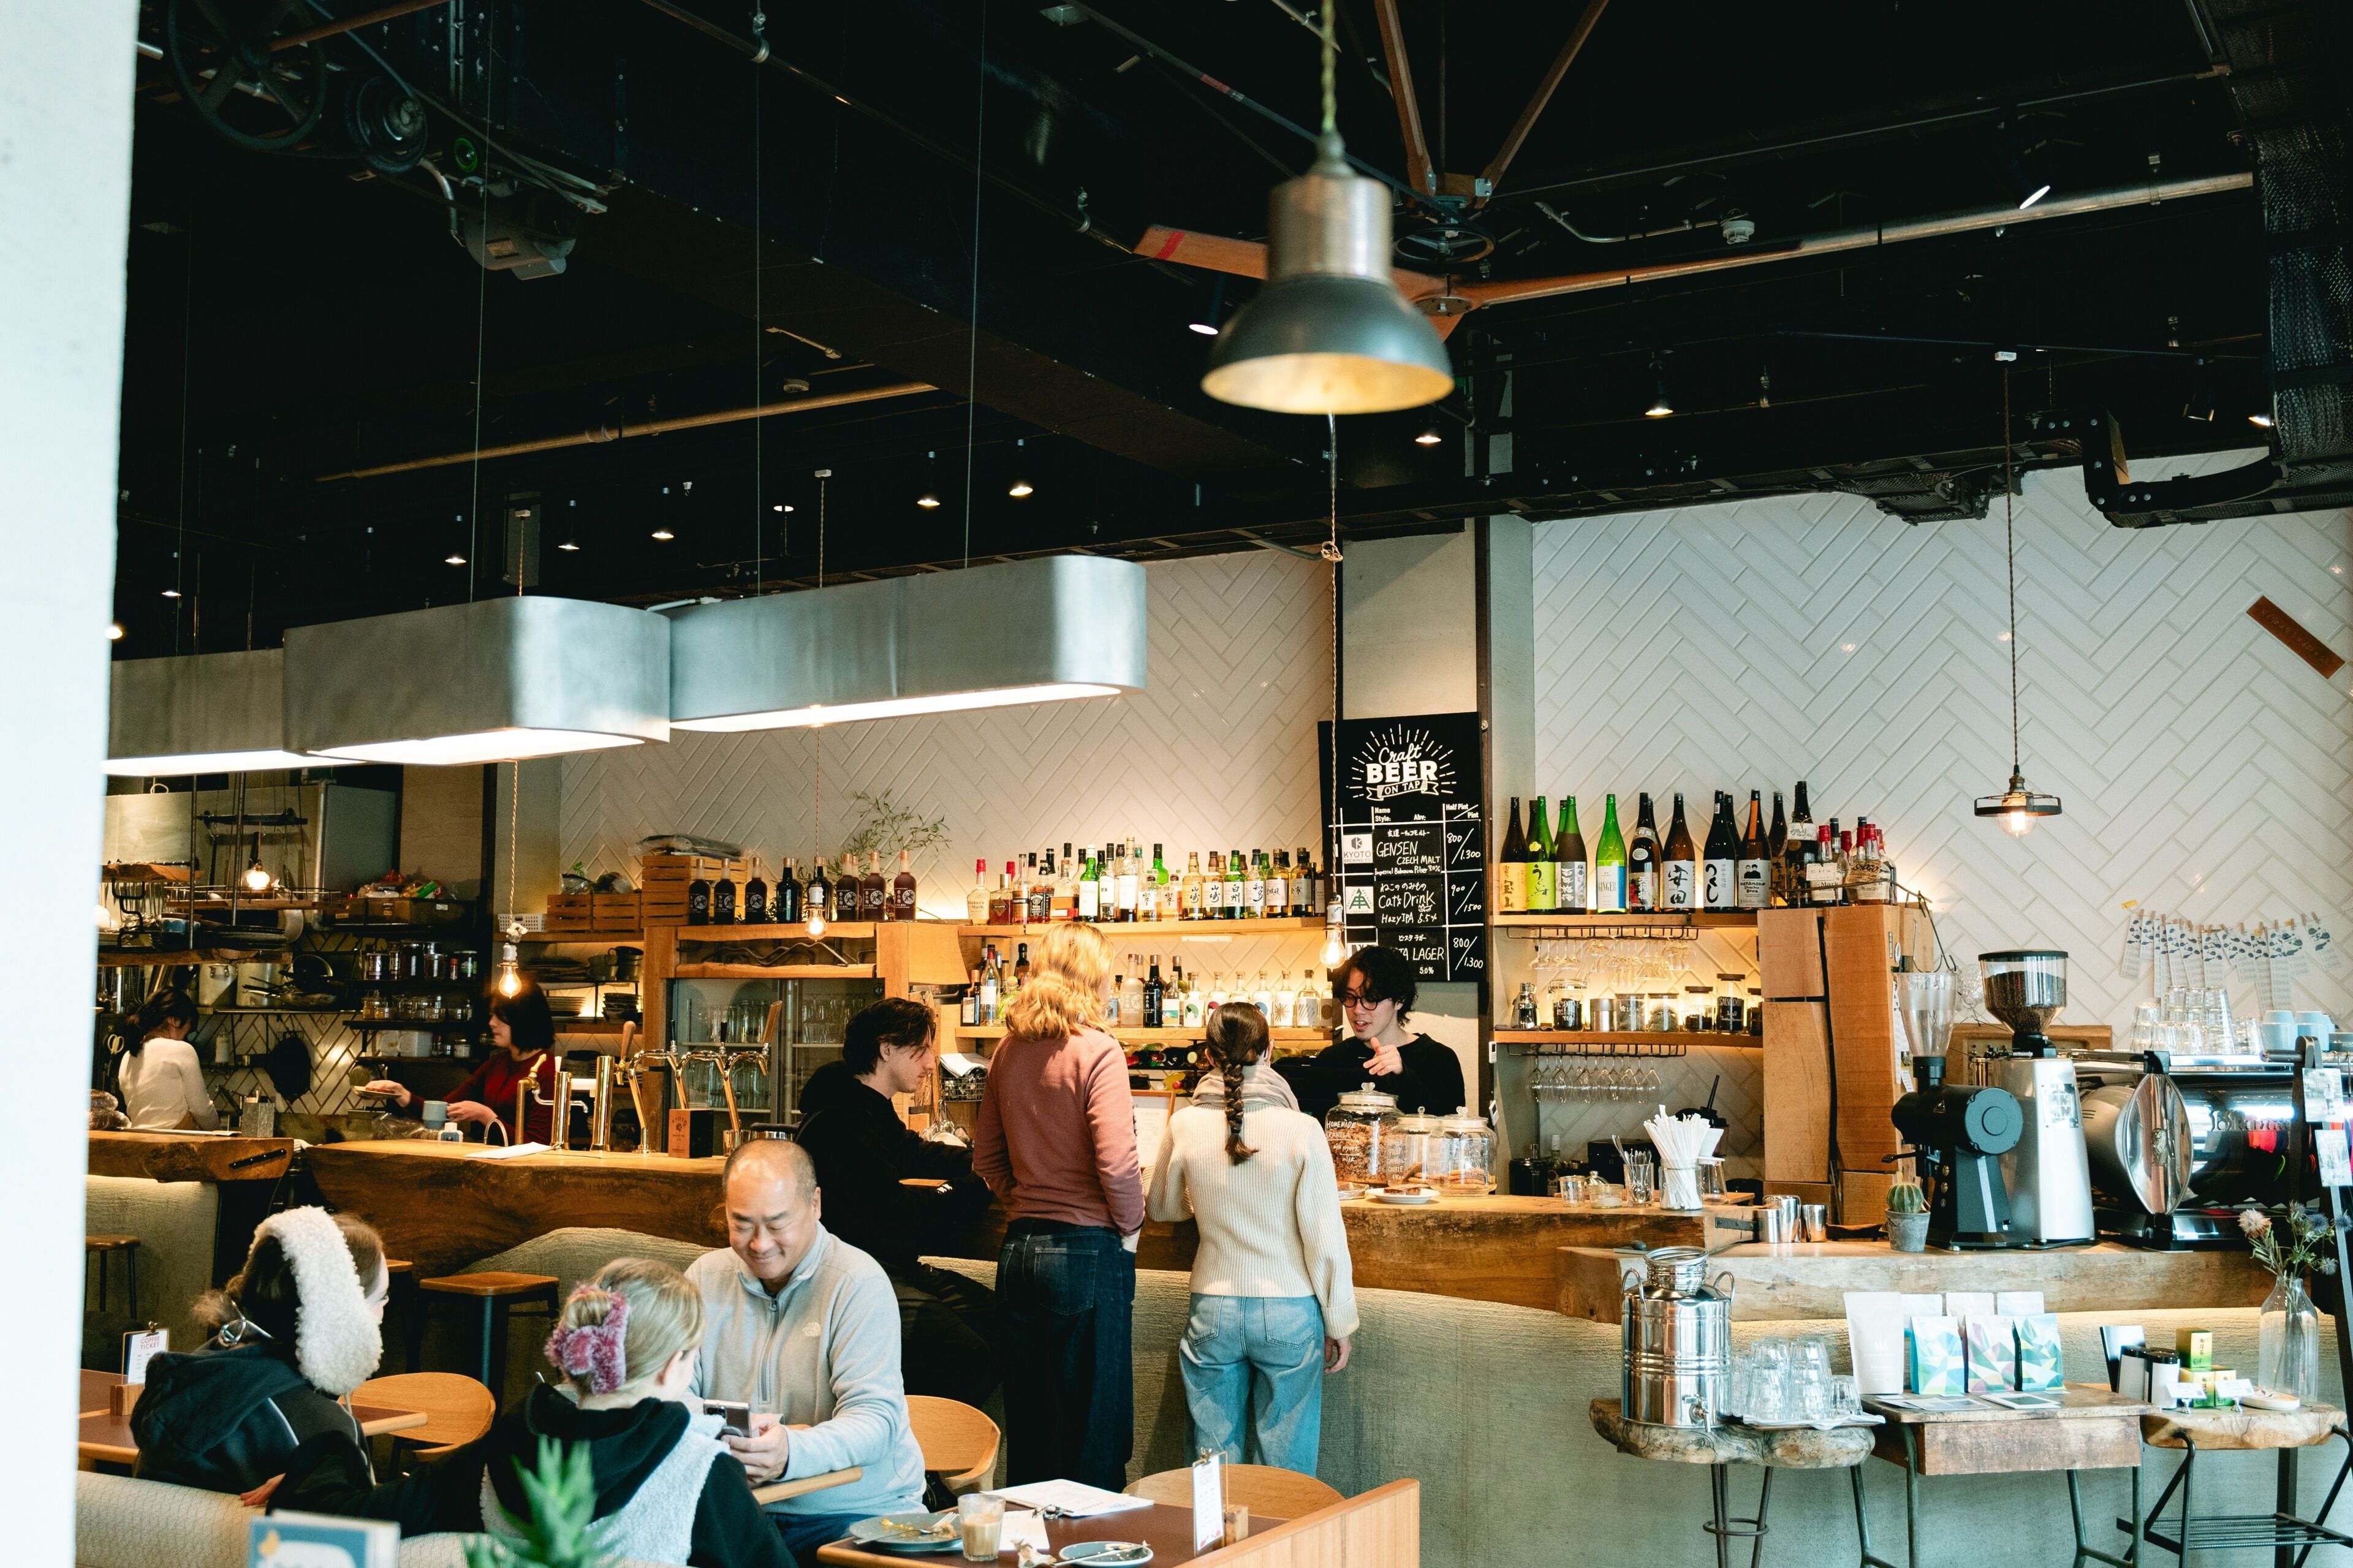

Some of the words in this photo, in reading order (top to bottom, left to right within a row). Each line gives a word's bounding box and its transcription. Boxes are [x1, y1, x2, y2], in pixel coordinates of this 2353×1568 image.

[1379, 743, 1422, 765] Craft
[1366, 760, 1438, 784] BEER
[1384, 786, 1399, 795] ON
[1402, 780, 1421, 791] TAP
[1446, 833, 1463, 844] 800
[1376, 841, 1419, 858] GENSEN
[1396, 856, 1419, 866] CZECH
[1420, 855, 1441, 864] MALT
[1450, 884, 1466, 897] 900
[1598, 881, 1617, 892] GINGER
[1668, 864, 1689, 905] 安田
[1705, 863, 1719, 904] つくし
[1231, 884, 1240, 903] 白州
[1252, 882, 1264, 902] 知多
[1379, 895, 1402, 909] Cat's
[1463, 904, 1482, 913] 1500
[1381, 914, 1401, 925] Hazy
[1401, 912, 1414, 925] IPA
[1417, 914, 1438, 924] 5.5%
[1453, 937, 1470, 949] 800
[1412, 946, 1445, 961] LAGER
[1419, 966, 1434, 975] 5.0%
